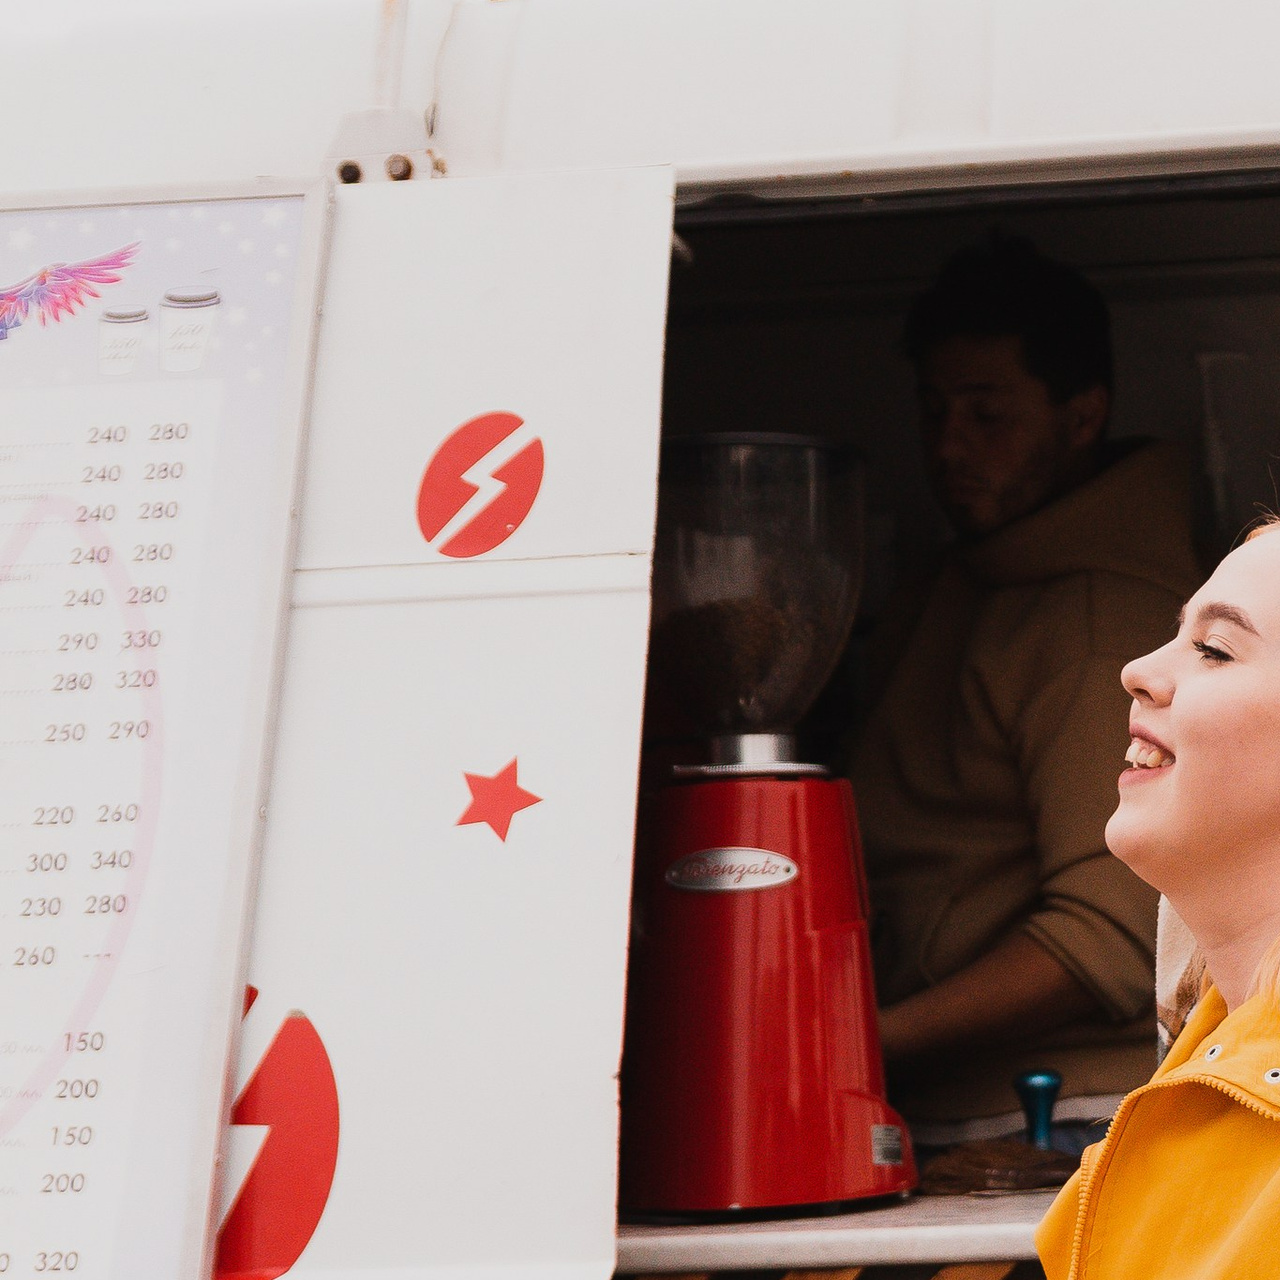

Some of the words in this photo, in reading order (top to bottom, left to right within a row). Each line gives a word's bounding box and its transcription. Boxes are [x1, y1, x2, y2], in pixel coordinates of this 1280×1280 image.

[88, 427, 126, 443] 240
[149, 424, 188, 440] 280
[82, 466, 120, 483] 240
[145, 463, 183, 480] 280
[75, 505, 115, 522] 240
[140, 502, 177, 519] 280
[71, 546, 110, 564] 240
[134, 544, 172, 561] 280
[64, 589, 104, 607] 240
[126, 586, 167, 604] 280
[58, 633, 97, 651] 290
[124, 631, 161, 648] 330
[53, 673, 92, 691] 280
[118, 669, 156, 688] 320
[45, 724, 85, 742] 250
[110, 720, 149, 739] 290
[34, 807, 73, 825] 220
[97, 804, 138, 822] 260
[28, 853, 67, 872] 300
[92, 851, 131, 869] 340
[20, 898, 61, 916] 230
[84, 895, 126, 914] 280
[14, 947, 55, 966] 260
[65, 1032, 104, 1051] 150
[56, 1079, 98, 1098] 200
[54, 1126, 92, 1145] 150
[41, 1174, 84, 1193] 200
[35, 1252, 78, 1271] 320
